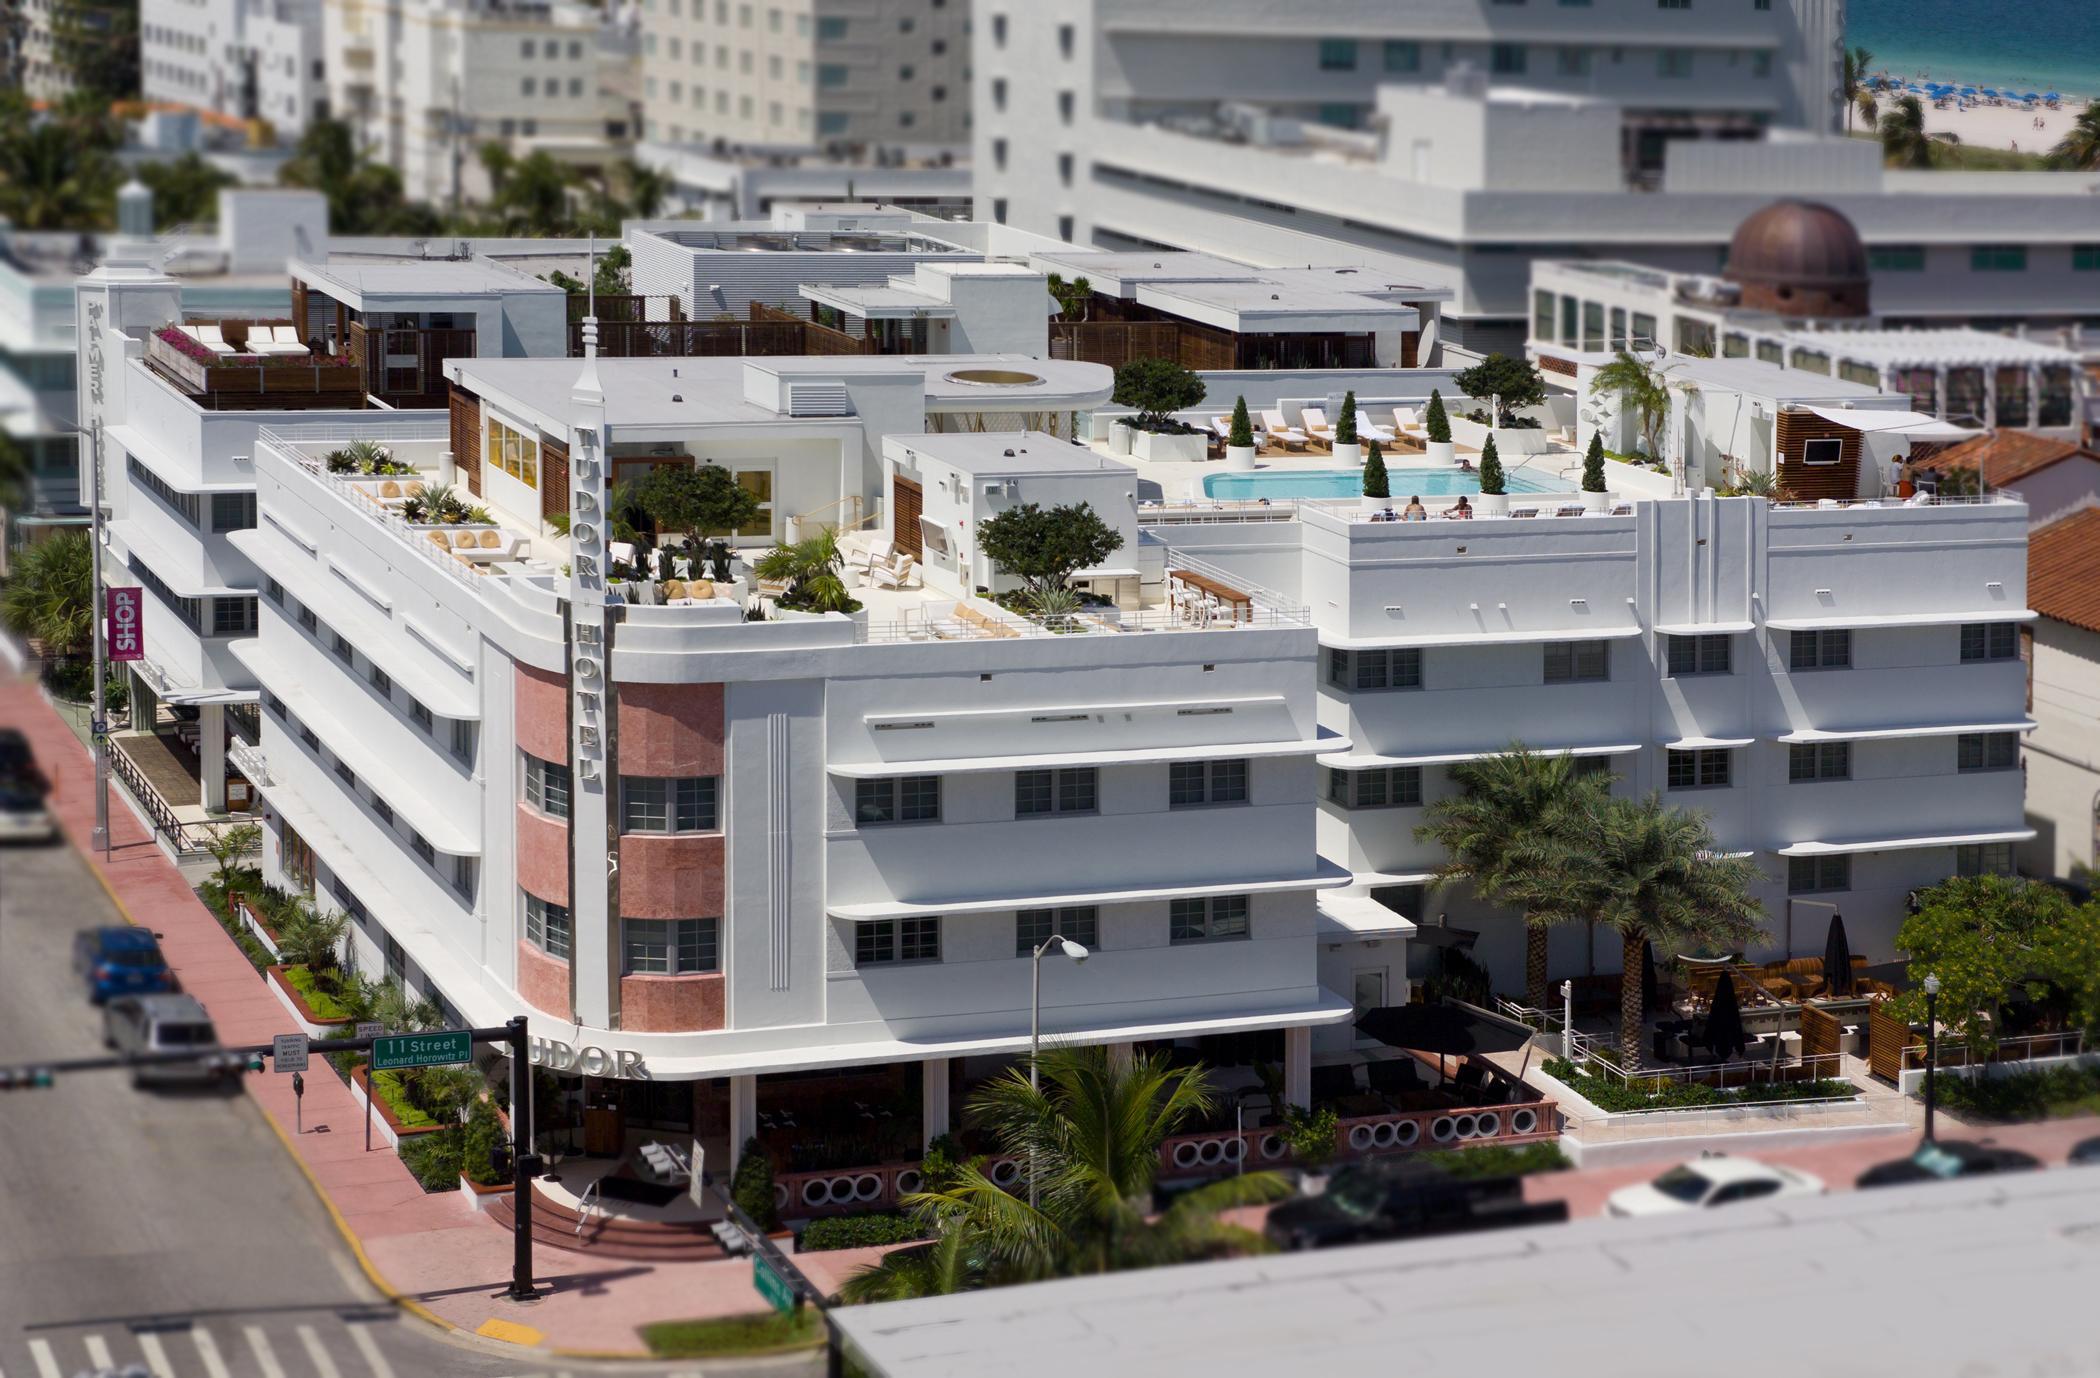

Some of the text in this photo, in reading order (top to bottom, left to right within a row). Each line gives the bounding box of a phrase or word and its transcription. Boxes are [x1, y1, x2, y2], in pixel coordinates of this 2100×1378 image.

[573, 427, 600, 780] TUDOR HOTEL
[115, 592, 136, 651] SHOP
[358, 1025, 383, 1033] SPEED
[389, 1038, 457, 1054] 11 Street
[377, 1050, 468, 1066] Leonard Horowitz Pl
